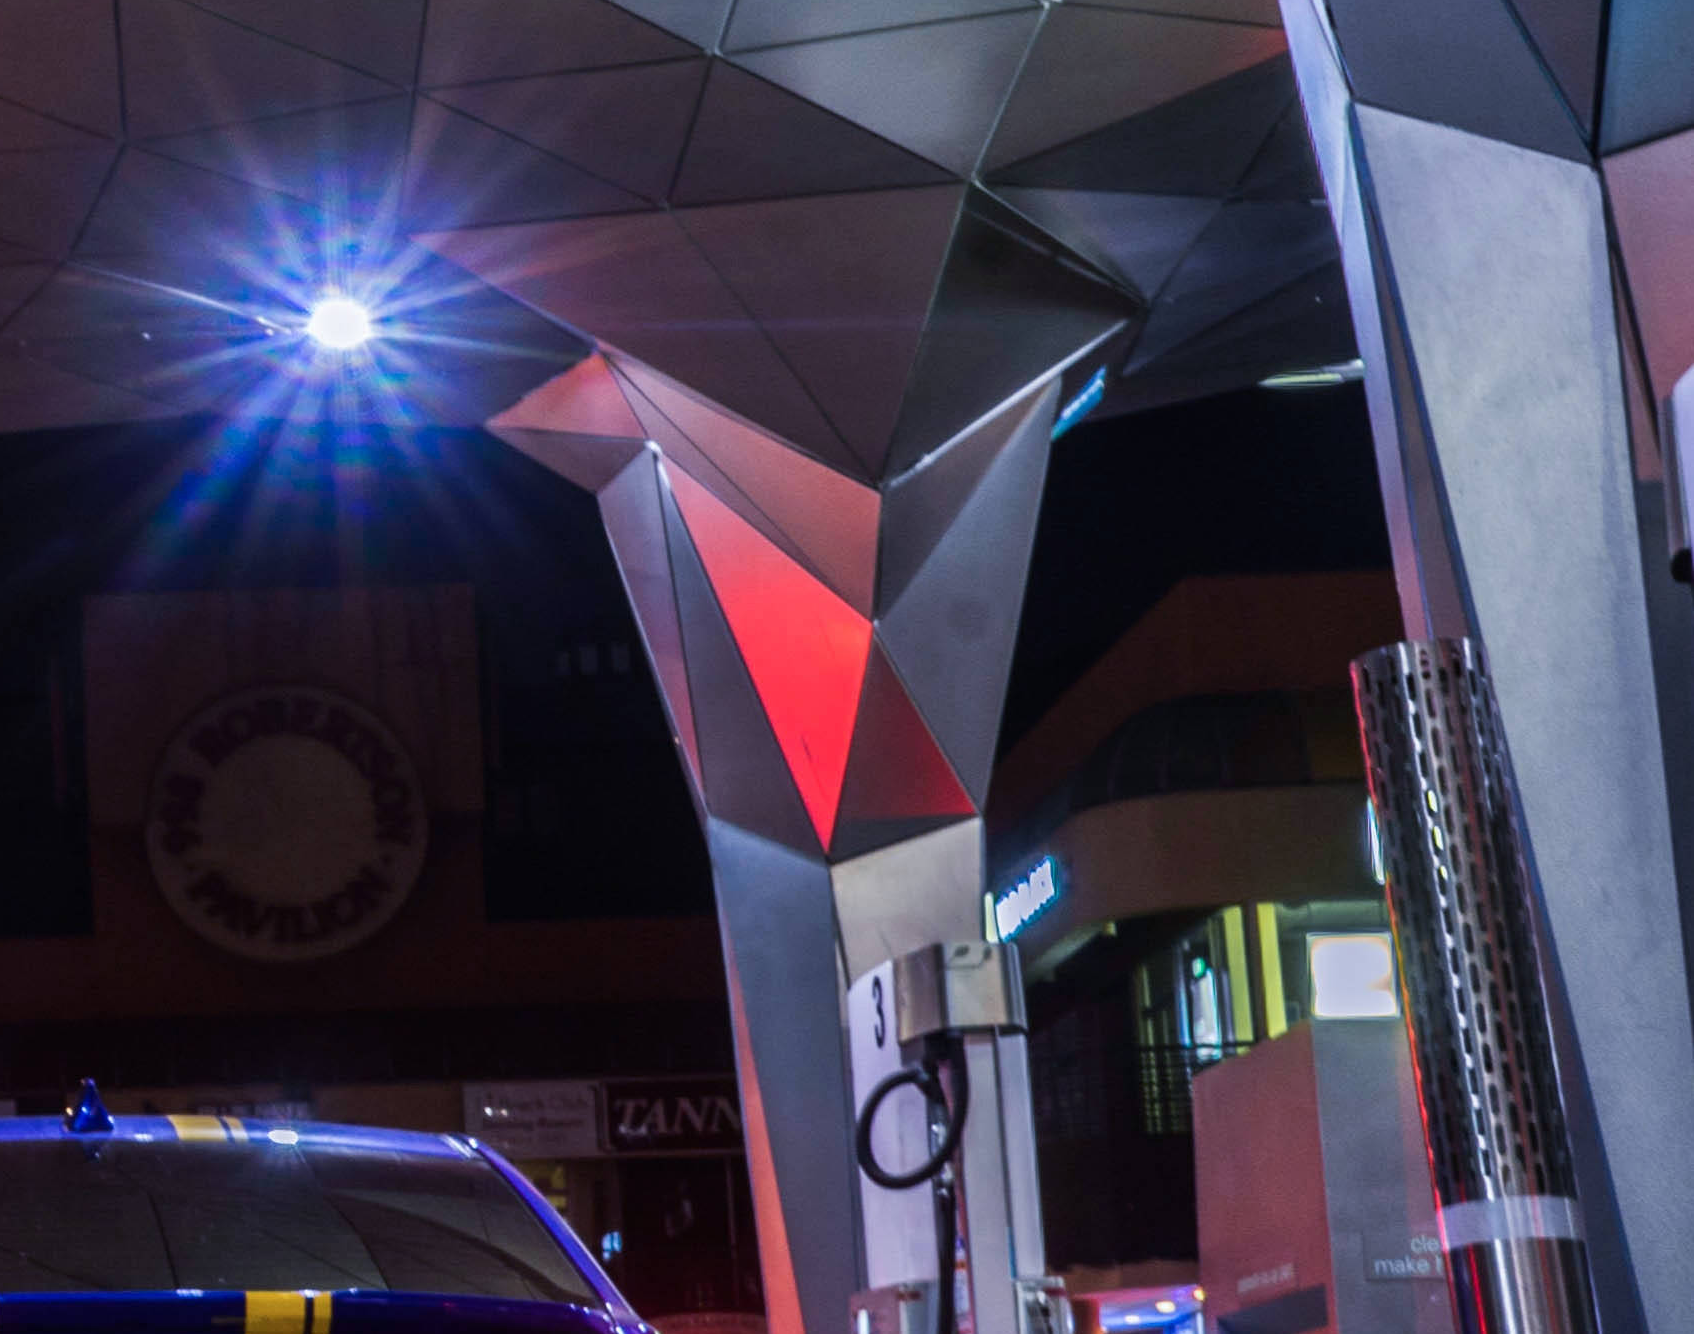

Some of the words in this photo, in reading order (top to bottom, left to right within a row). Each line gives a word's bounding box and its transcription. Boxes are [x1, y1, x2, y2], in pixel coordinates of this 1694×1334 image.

[188, 698, 411, 845] ROBERTSON
[187, 865, 390, 944] PAVILION
[872, 974, 886, 1049] 3
[1373, 1254, 1430, 1275] make
